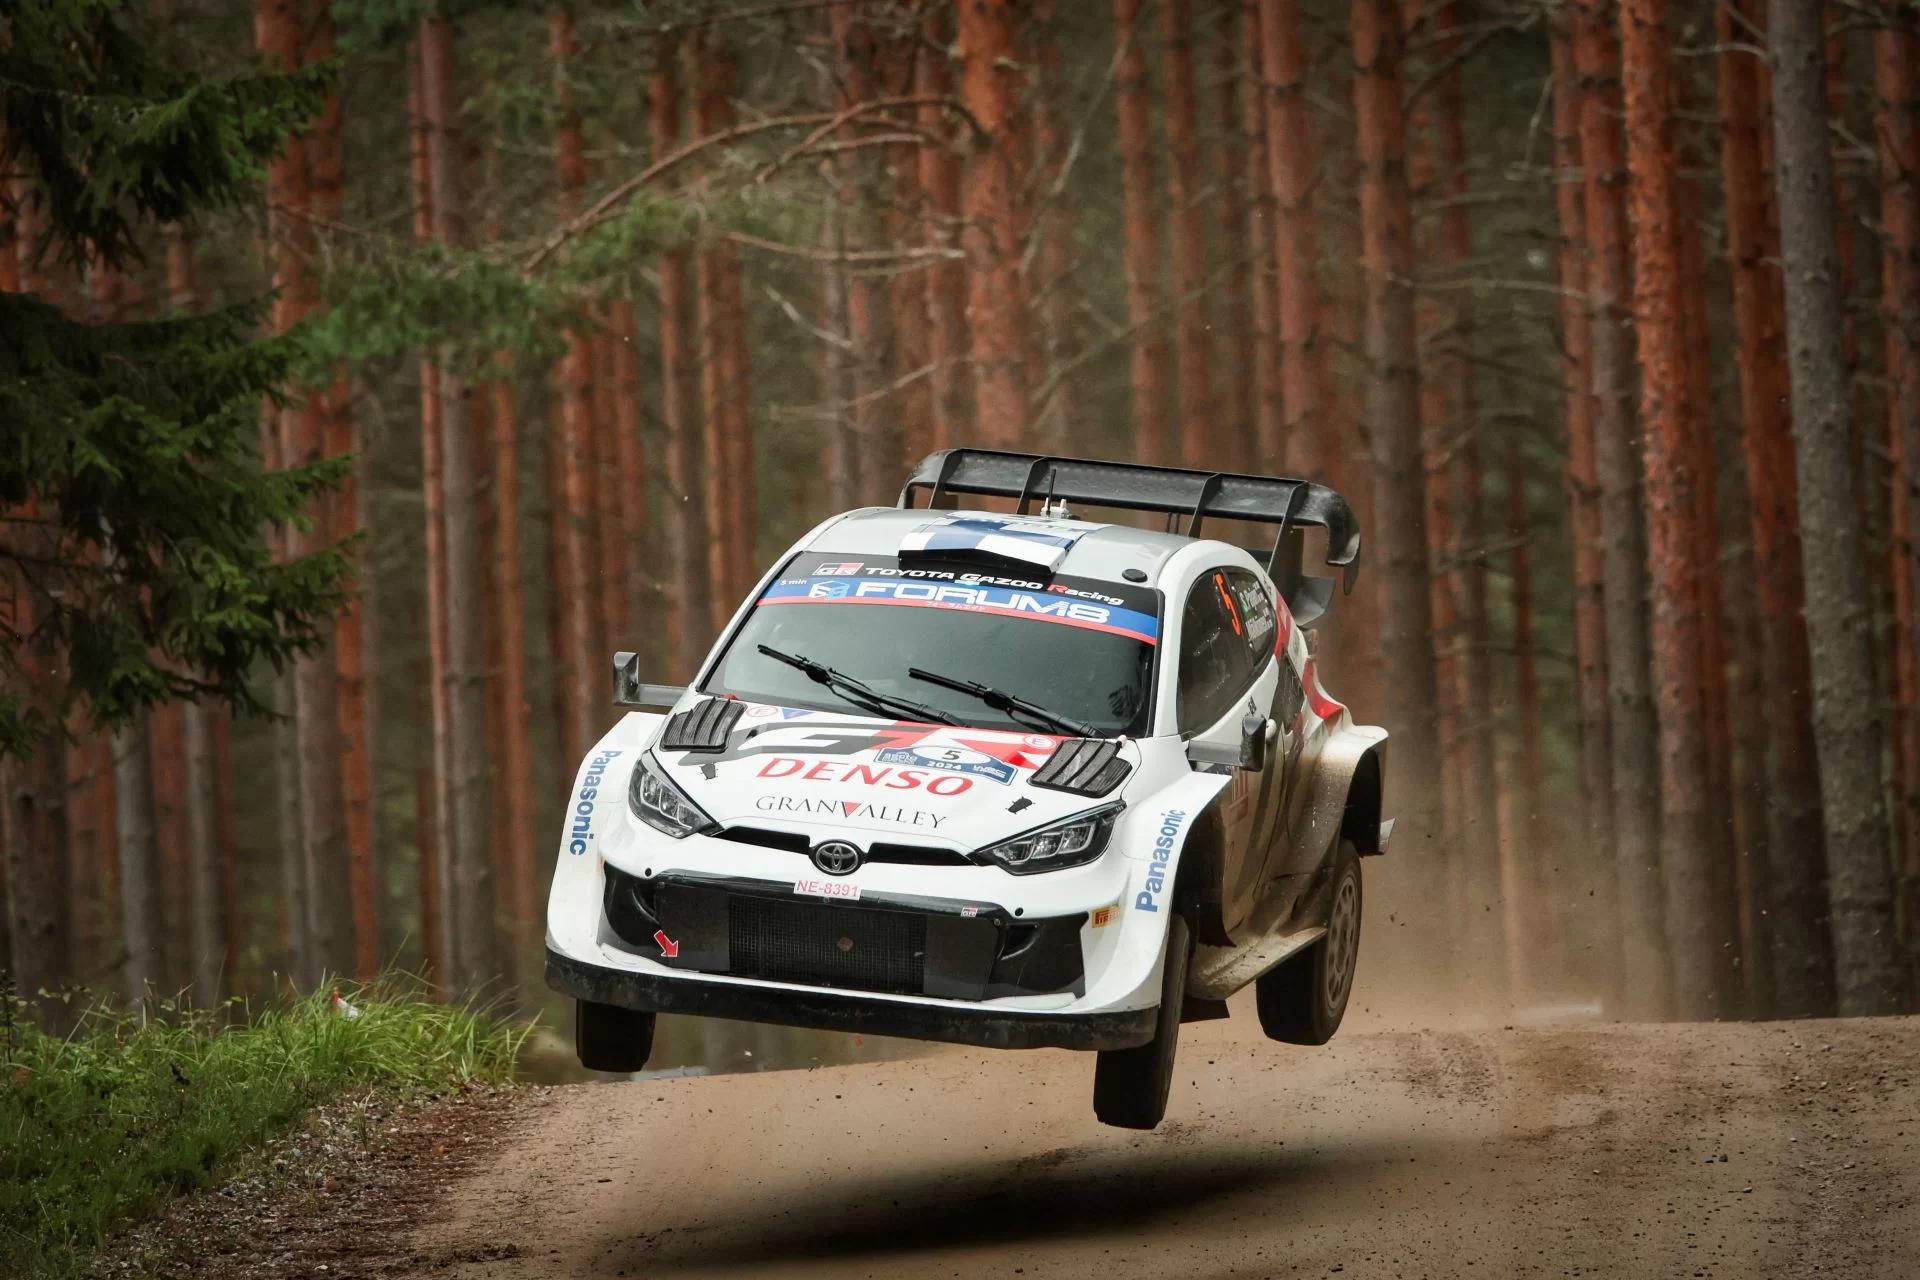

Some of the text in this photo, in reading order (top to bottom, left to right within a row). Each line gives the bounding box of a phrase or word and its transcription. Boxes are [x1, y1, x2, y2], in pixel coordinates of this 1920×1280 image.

[855, 582, 1111, 624] FORUM8
[866, 567, 1125, 605] TOYOTA GAZOO Racing
[927, 762, 962, 771] 2024
[941, 750, 961, 760] 5
[756, 757, 974, 796] DENSO
[569, 750, 624, 856] Panasonic
[1135, 809, 1186, 913] Panasonic
[796, 880, 859, 898] NE-8391
